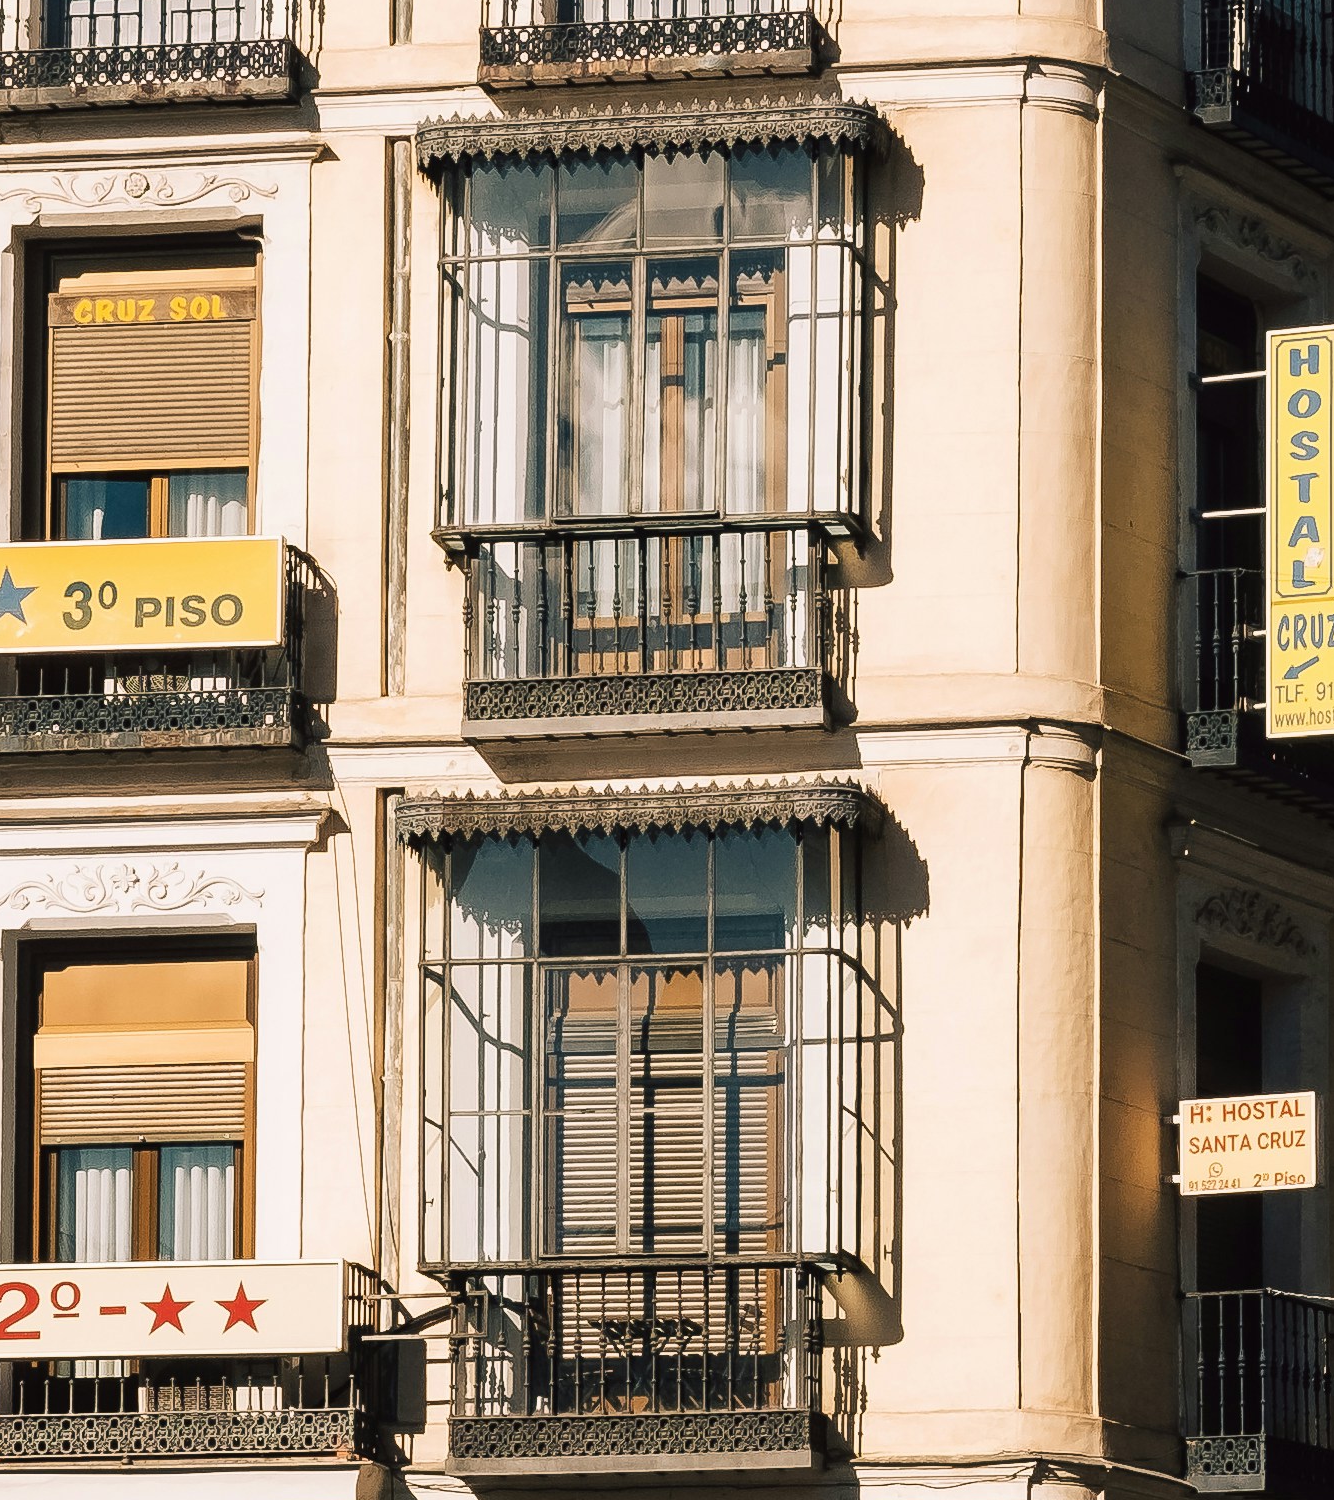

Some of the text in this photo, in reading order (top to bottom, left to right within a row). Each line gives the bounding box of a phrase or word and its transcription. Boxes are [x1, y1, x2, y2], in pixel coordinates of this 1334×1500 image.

[74, 295, 226, 322] CRUZ SOL
[1287, 344, 1321, 588] HOSTAL
[134, 595, 244, 628] PISO
[1275, 685, 1308, 704] TLF.
[1317, 682, 1333, 701] 91
[1223, 1099, 1305, 1122] HOSTAL
[1189, 1130, 1306, 1154] SANTA CRUZ
[1274, 1171, 1306, 1187] Piso
